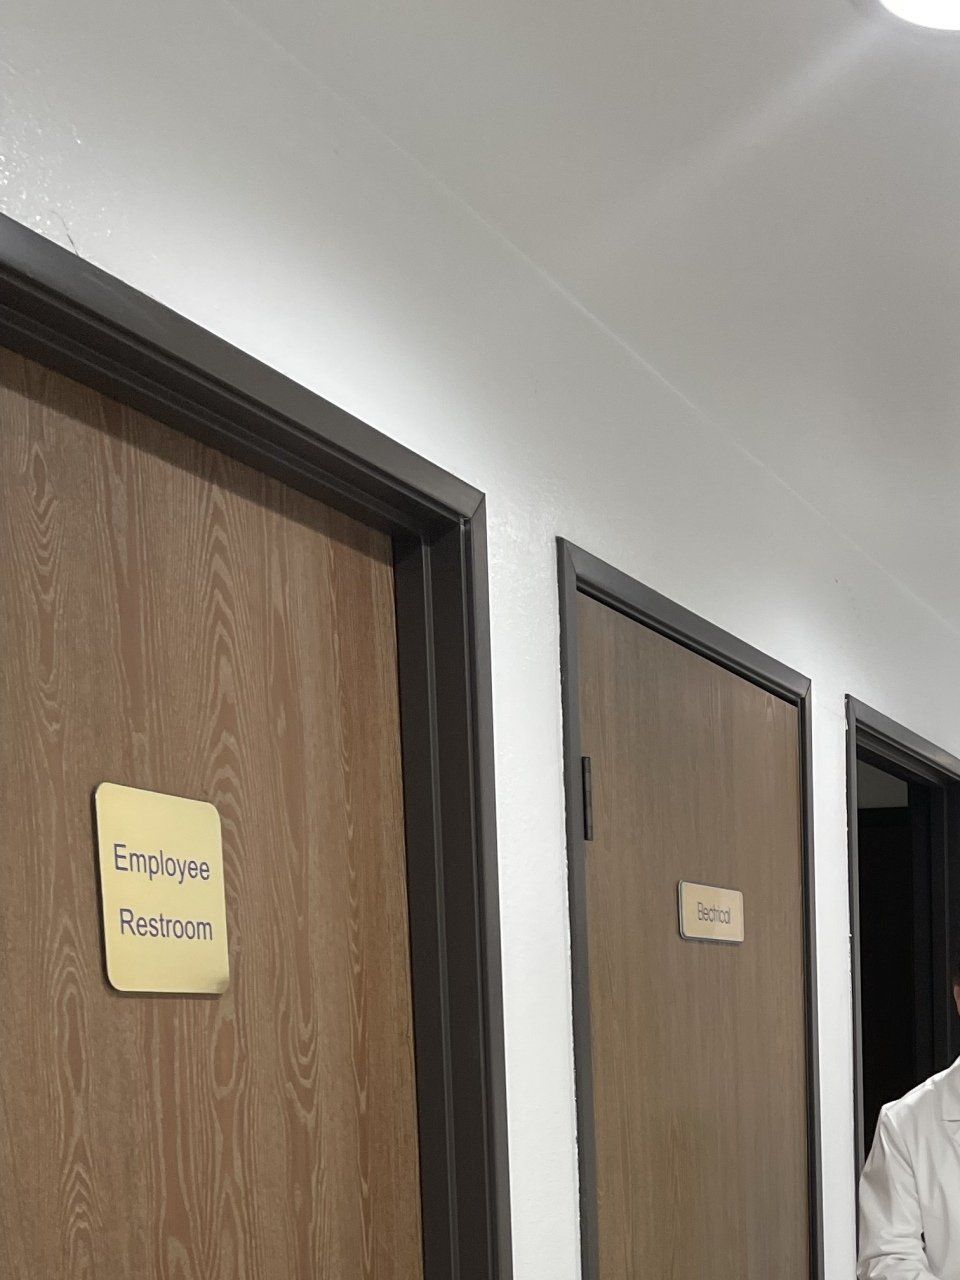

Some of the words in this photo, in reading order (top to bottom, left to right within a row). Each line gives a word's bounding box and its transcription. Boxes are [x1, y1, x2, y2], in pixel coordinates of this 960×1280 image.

[113, 843, 210, 885] Employee
[119, 908, 213, 941] Restroom
[697, 901, 731, 924] Electrical
